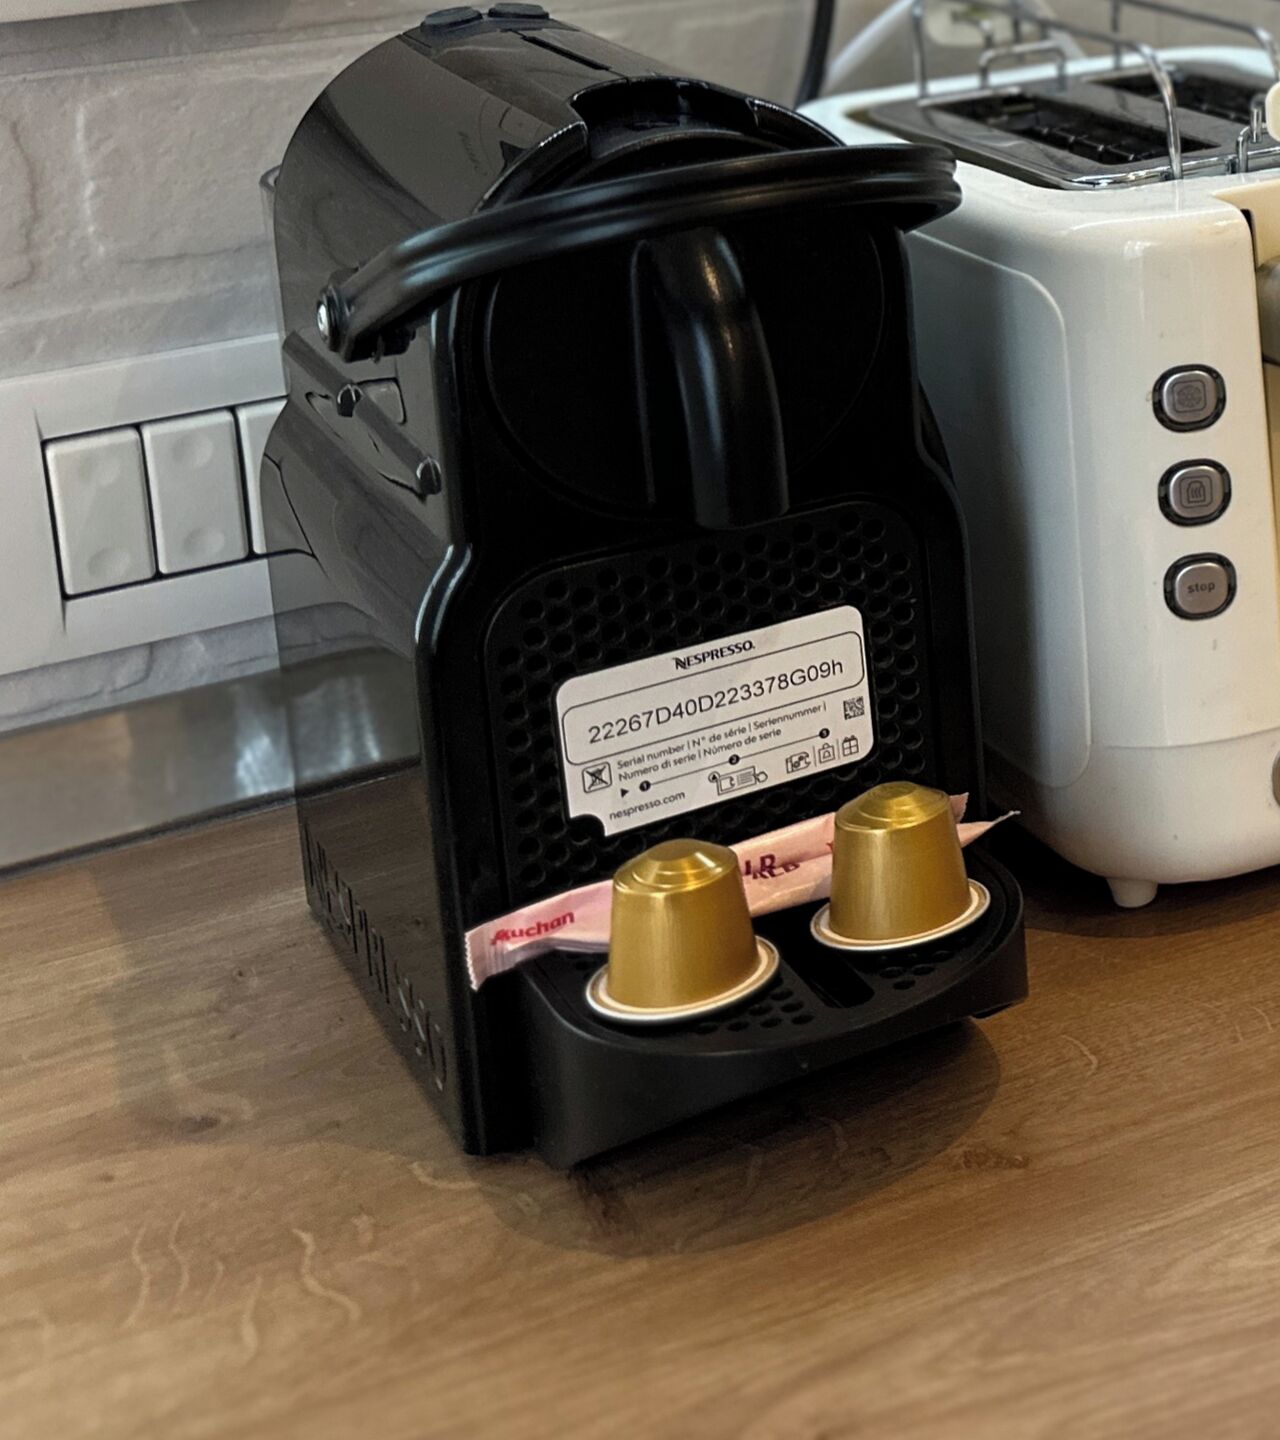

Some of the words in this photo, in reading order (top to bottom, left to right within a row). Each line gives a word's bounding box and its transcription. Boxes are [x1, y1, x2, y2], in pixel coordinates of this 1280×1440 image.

[1187, 582, 1215, 593] stop
[588, 659, 844, 744] 22267D40D223378G09h
[617, 754, 645, 769] Serial
[647, 743, 685, 761] number
[709, 732, 722, 743] de
[753, 705, 822, 730] Seriennummer
[618, 764, 659, 782] Numero
[661, 758, 672, 769] di
[673, 752, 697, 766] serie
[703, 740, 743, 757] Número
[744, 733, 758, 744] de
[758, 727, 782, 742] serie
[610, 791, 686, 820] nespresso.com
[491, 911, 575, 946] Auchan
